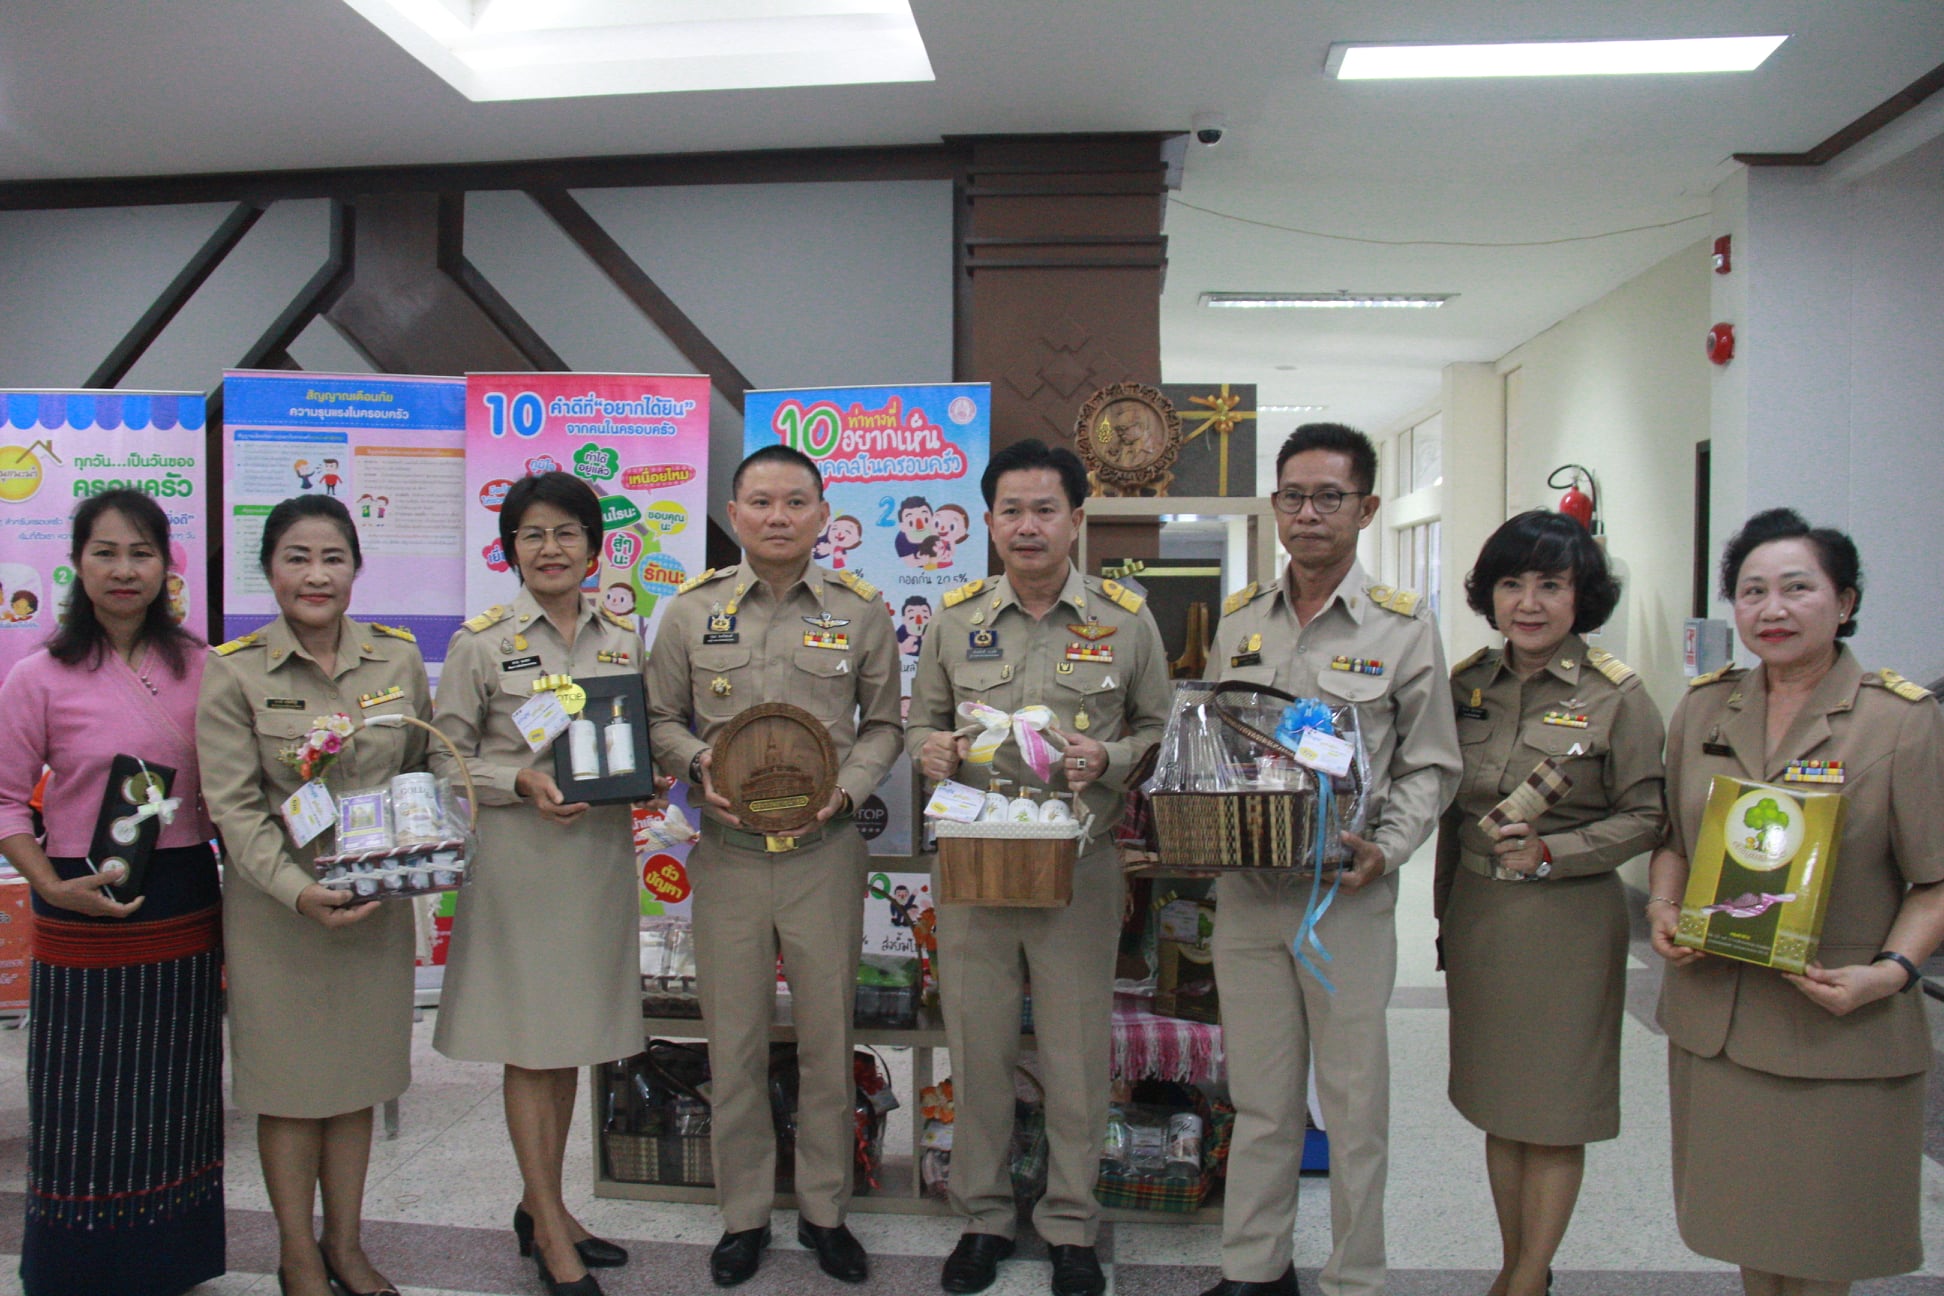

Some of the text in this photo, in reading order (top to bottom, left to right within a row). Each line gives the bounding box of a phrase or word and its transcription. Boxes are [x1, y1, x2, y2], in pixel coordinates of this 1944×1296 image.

[289, 406, 410, 421] ความรุนแรงในครอบครัว
[485, 393, 544, 437] 10
[848, 401, 897, 428] ท่าทางที่
[566, 419, 677, 436] จากคนในครอบครัว
[777, 404, 841, 458] 10
[842, 413, 941, 452] อยากเห็น
[818, 449, 962, 478] คคลในครอบครัว
[603, 504, 638, 523] นไรนะ
[876, 495, 897, 528] 2
[58, 570, 68, 583] 2
[643, 562, 687, 586] รักนะ
